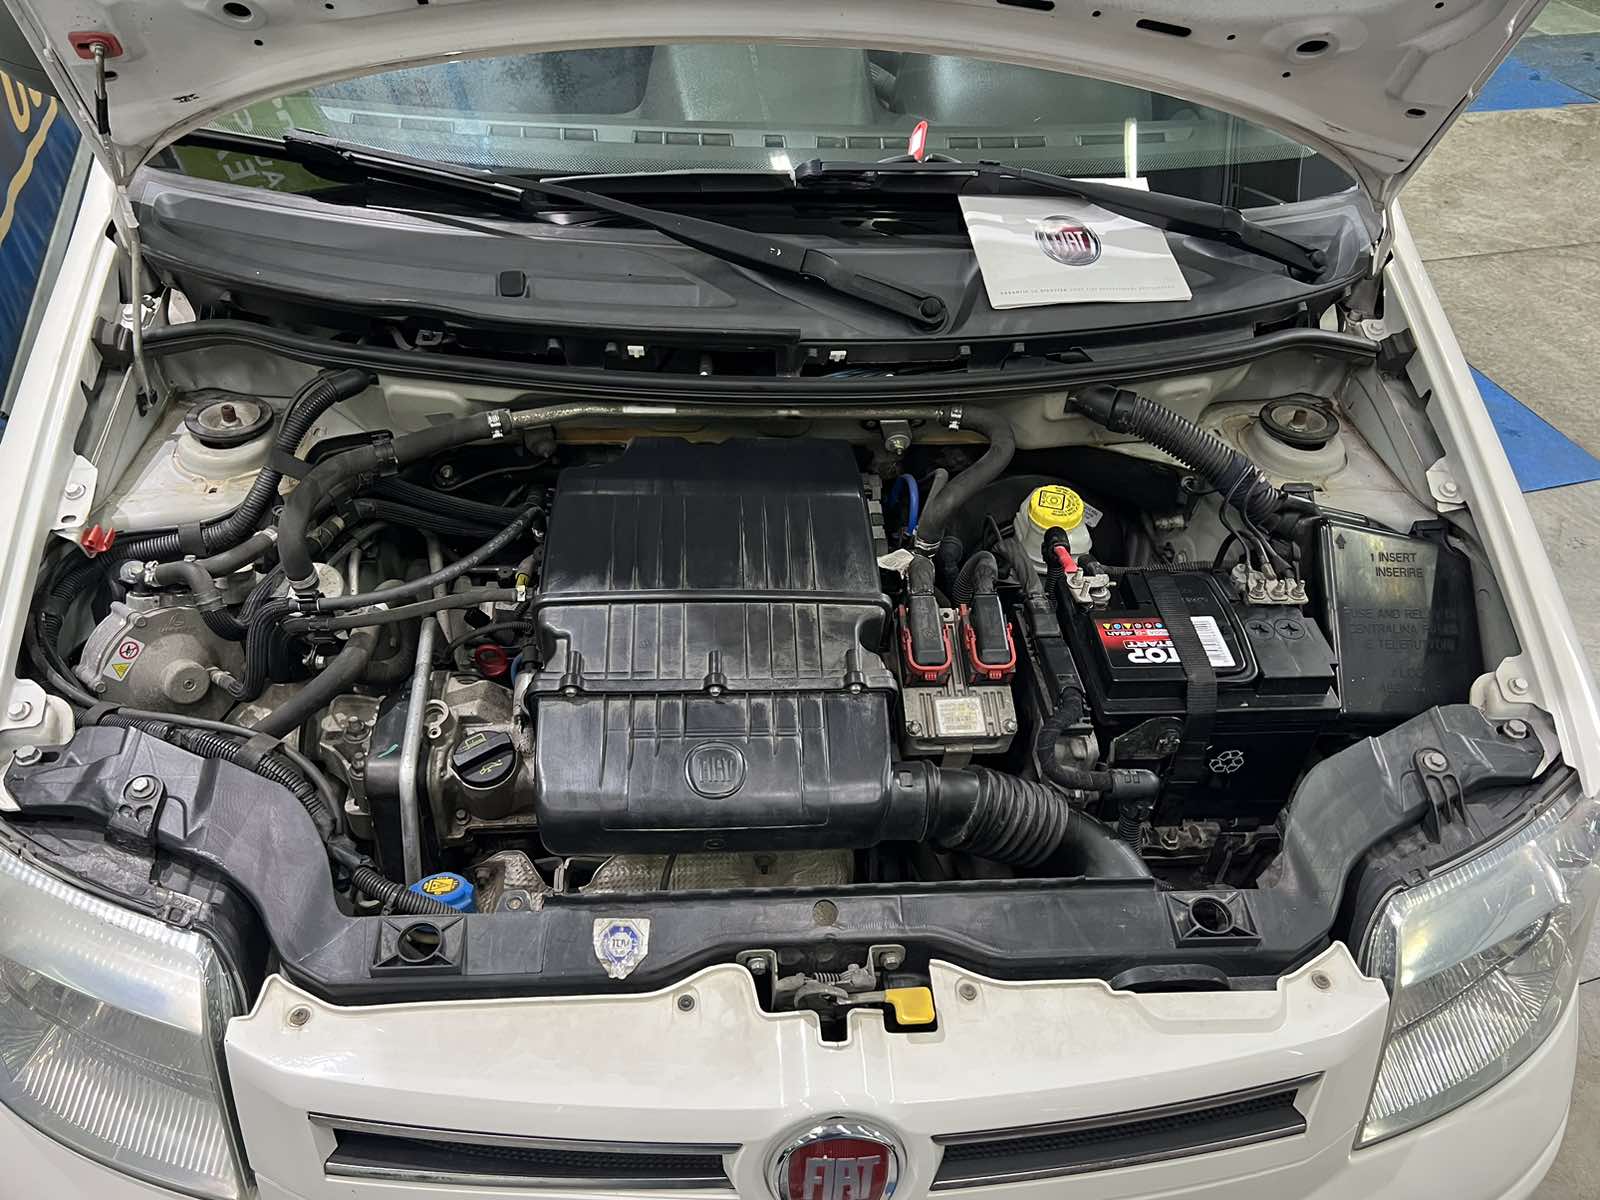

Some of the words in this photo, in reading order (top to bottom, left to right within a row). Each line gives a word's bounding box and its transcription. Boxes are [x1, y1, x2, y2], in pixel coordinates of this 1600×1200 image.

[1378, 552, 1418, 563] INSERT
[1375, 567, 1425, 578] INSERIRE
[699, 756, 734, 782] FIAT
[803, 1155, 881, 1200] FIAT
